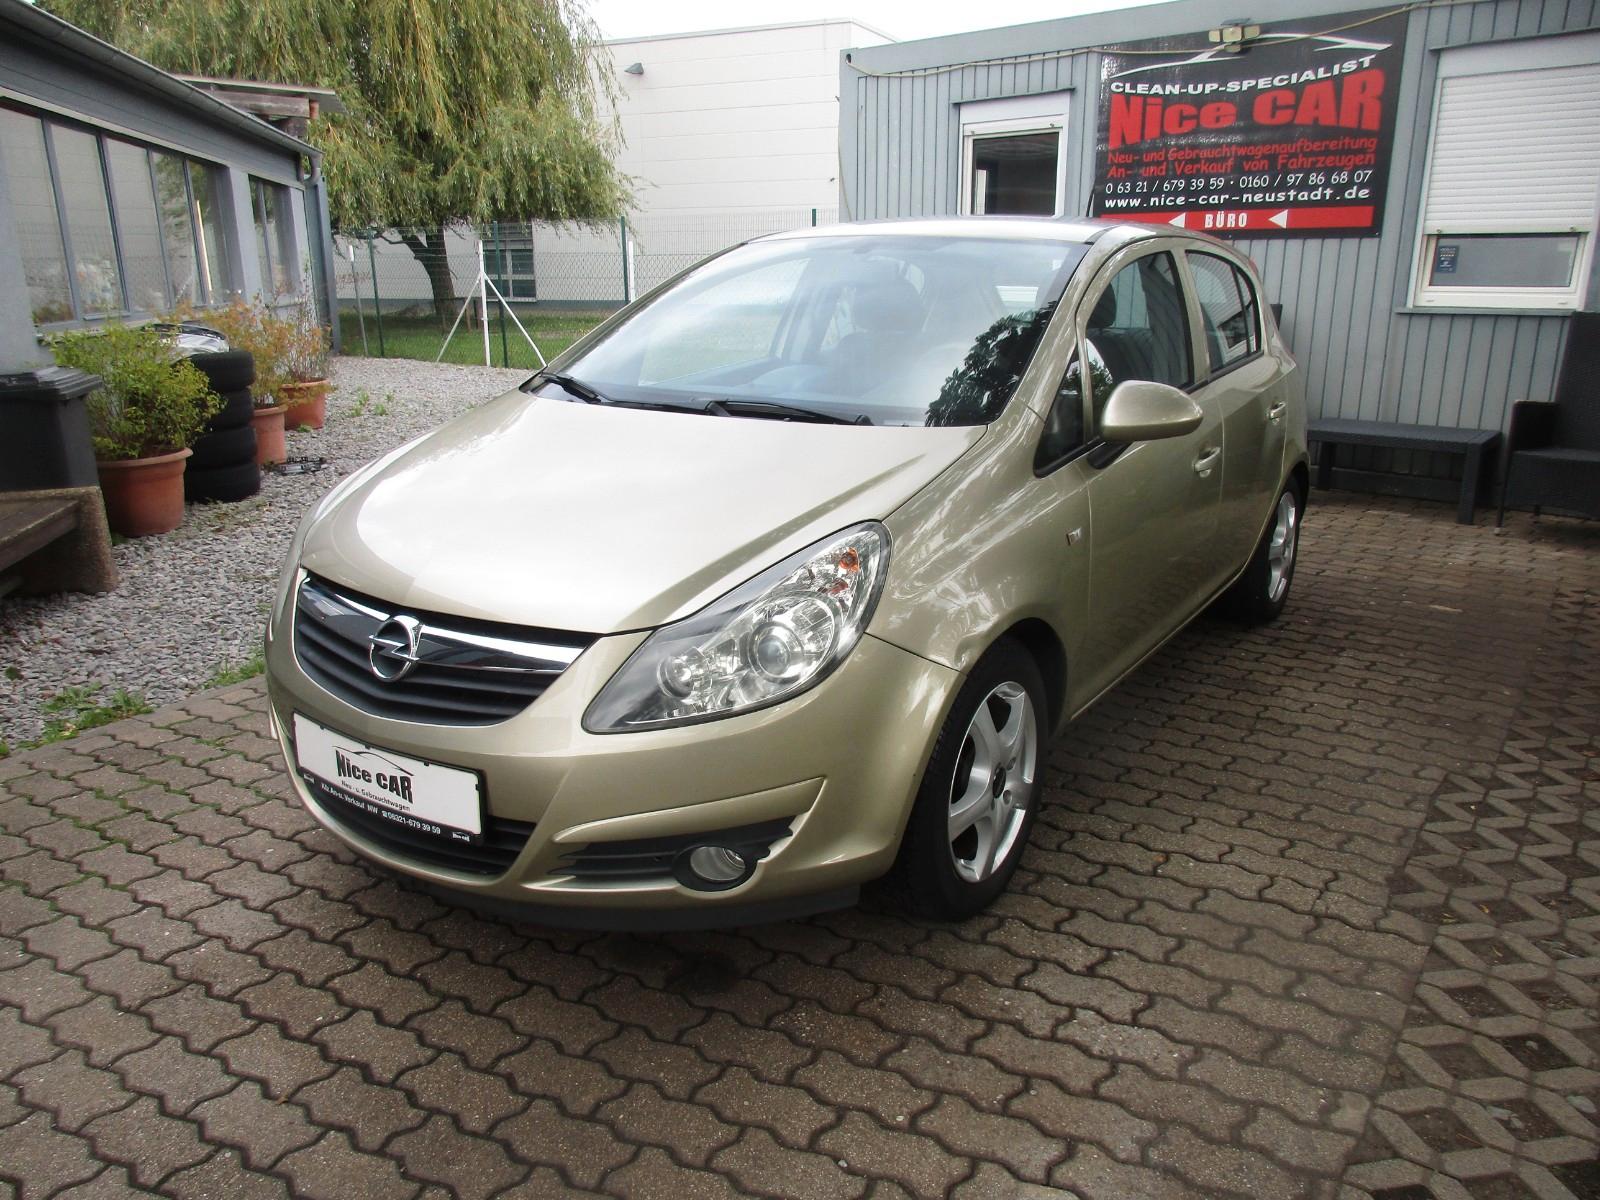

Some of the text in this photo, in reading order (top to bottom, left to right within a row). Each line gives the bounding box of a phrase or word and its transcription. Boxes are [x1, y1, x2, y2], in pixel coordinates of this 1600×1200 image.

[1110, 54, 1376, 95] CLEAN-UP-SPECIALIST
[1108, 94, 1238, 149] Nice
[1107, 137, 1377, 165] Neu- und Gebrauchtwagenaufbereitung
[1107, 152, 1376, 178] An- und Verkauf von Fahrzeugen
[1117, 182, 1131, 193] 63
[1135, 181, 1148, 193] 21
[1163, 179, 1185, 192] 679
[1190, 178, 1205, 190] 39
[1209, 177, 1225, 190] 59
[1239, 175, 1269, 188] 0160
[1286, 173, 1304, 186] 97
[1308, 171, 1325, 185] 86
[1331, 171, 1348, 184] 68
[1353, 170, 1373, 183] 07
[1105, 186, 1370, 208] www.nice-car-neustadt.de
[1204, 211, 1248, 229] BÜRO
[336, 749, 373, 784] Nice
